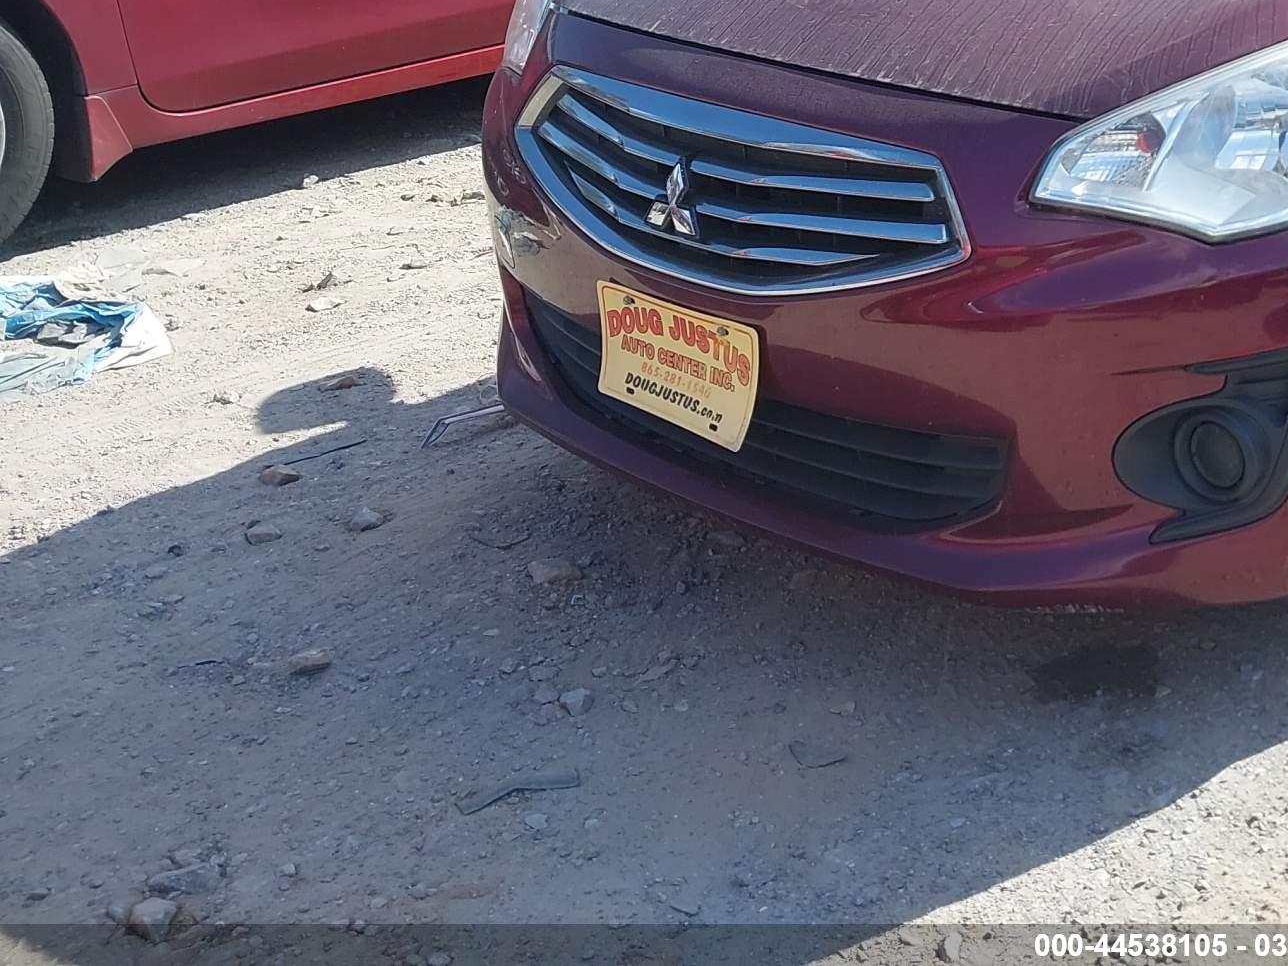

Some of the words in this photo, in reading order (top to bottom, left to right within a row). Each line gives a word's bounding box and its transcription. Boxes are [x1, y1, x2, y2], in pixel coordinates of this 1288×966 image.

[606, 306, 664, 338] DOUG
[668, 315, 751, 386] JUSTUS
[620, 334, 655, 361] AUTO
[657, 346, 707, 382] CENTER
[709, 365, 736, 393] INC.
